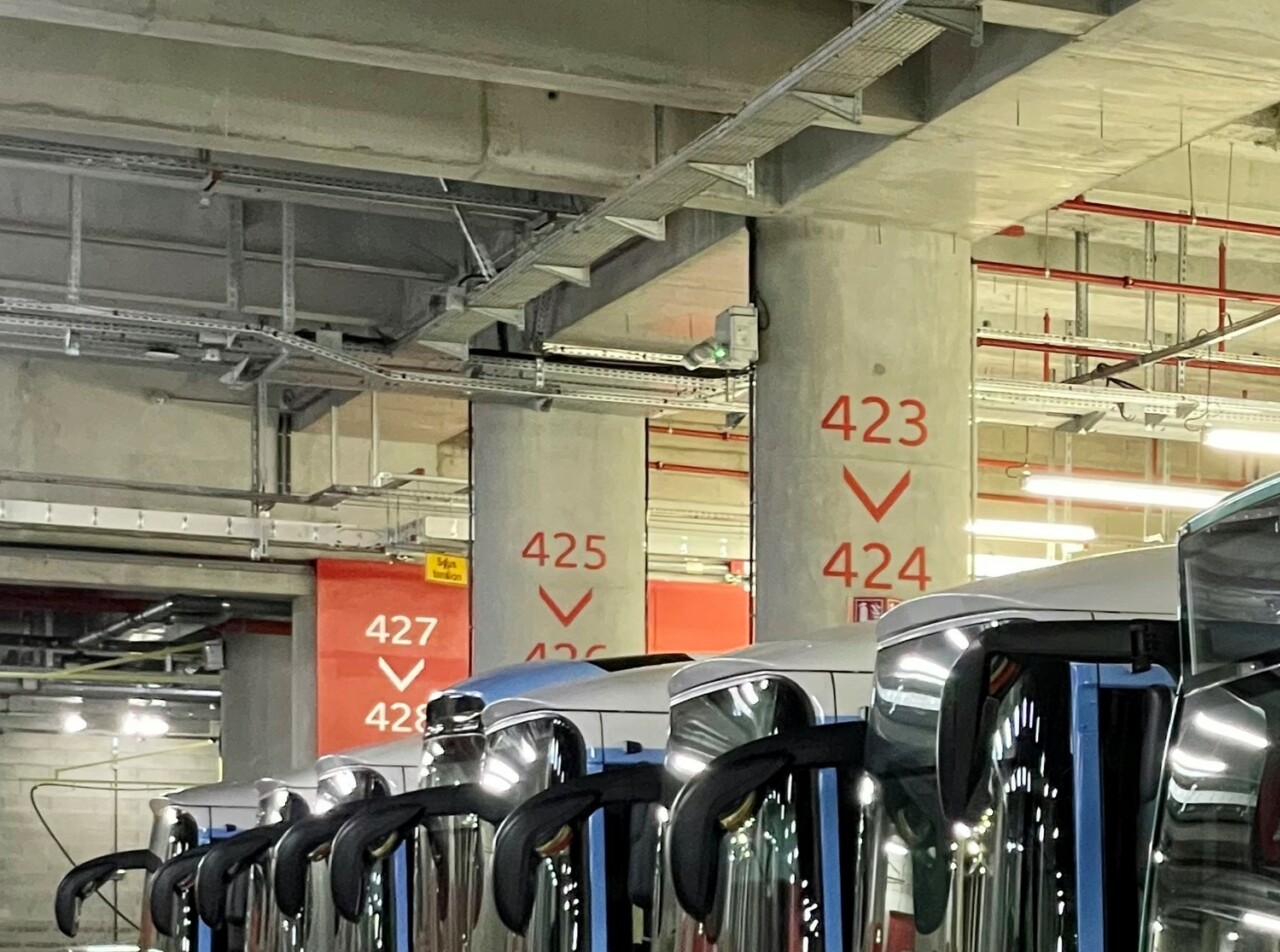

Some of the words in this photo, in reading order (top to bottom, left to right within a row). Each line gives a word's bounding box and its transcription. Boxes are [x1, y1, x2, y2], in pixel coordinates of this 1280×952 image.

[820, 395, 928, 447] 423
[521, 531, 606, 570] 425
[822, 542, 932, 592] 424
[365, 614, 438, 646] 427
